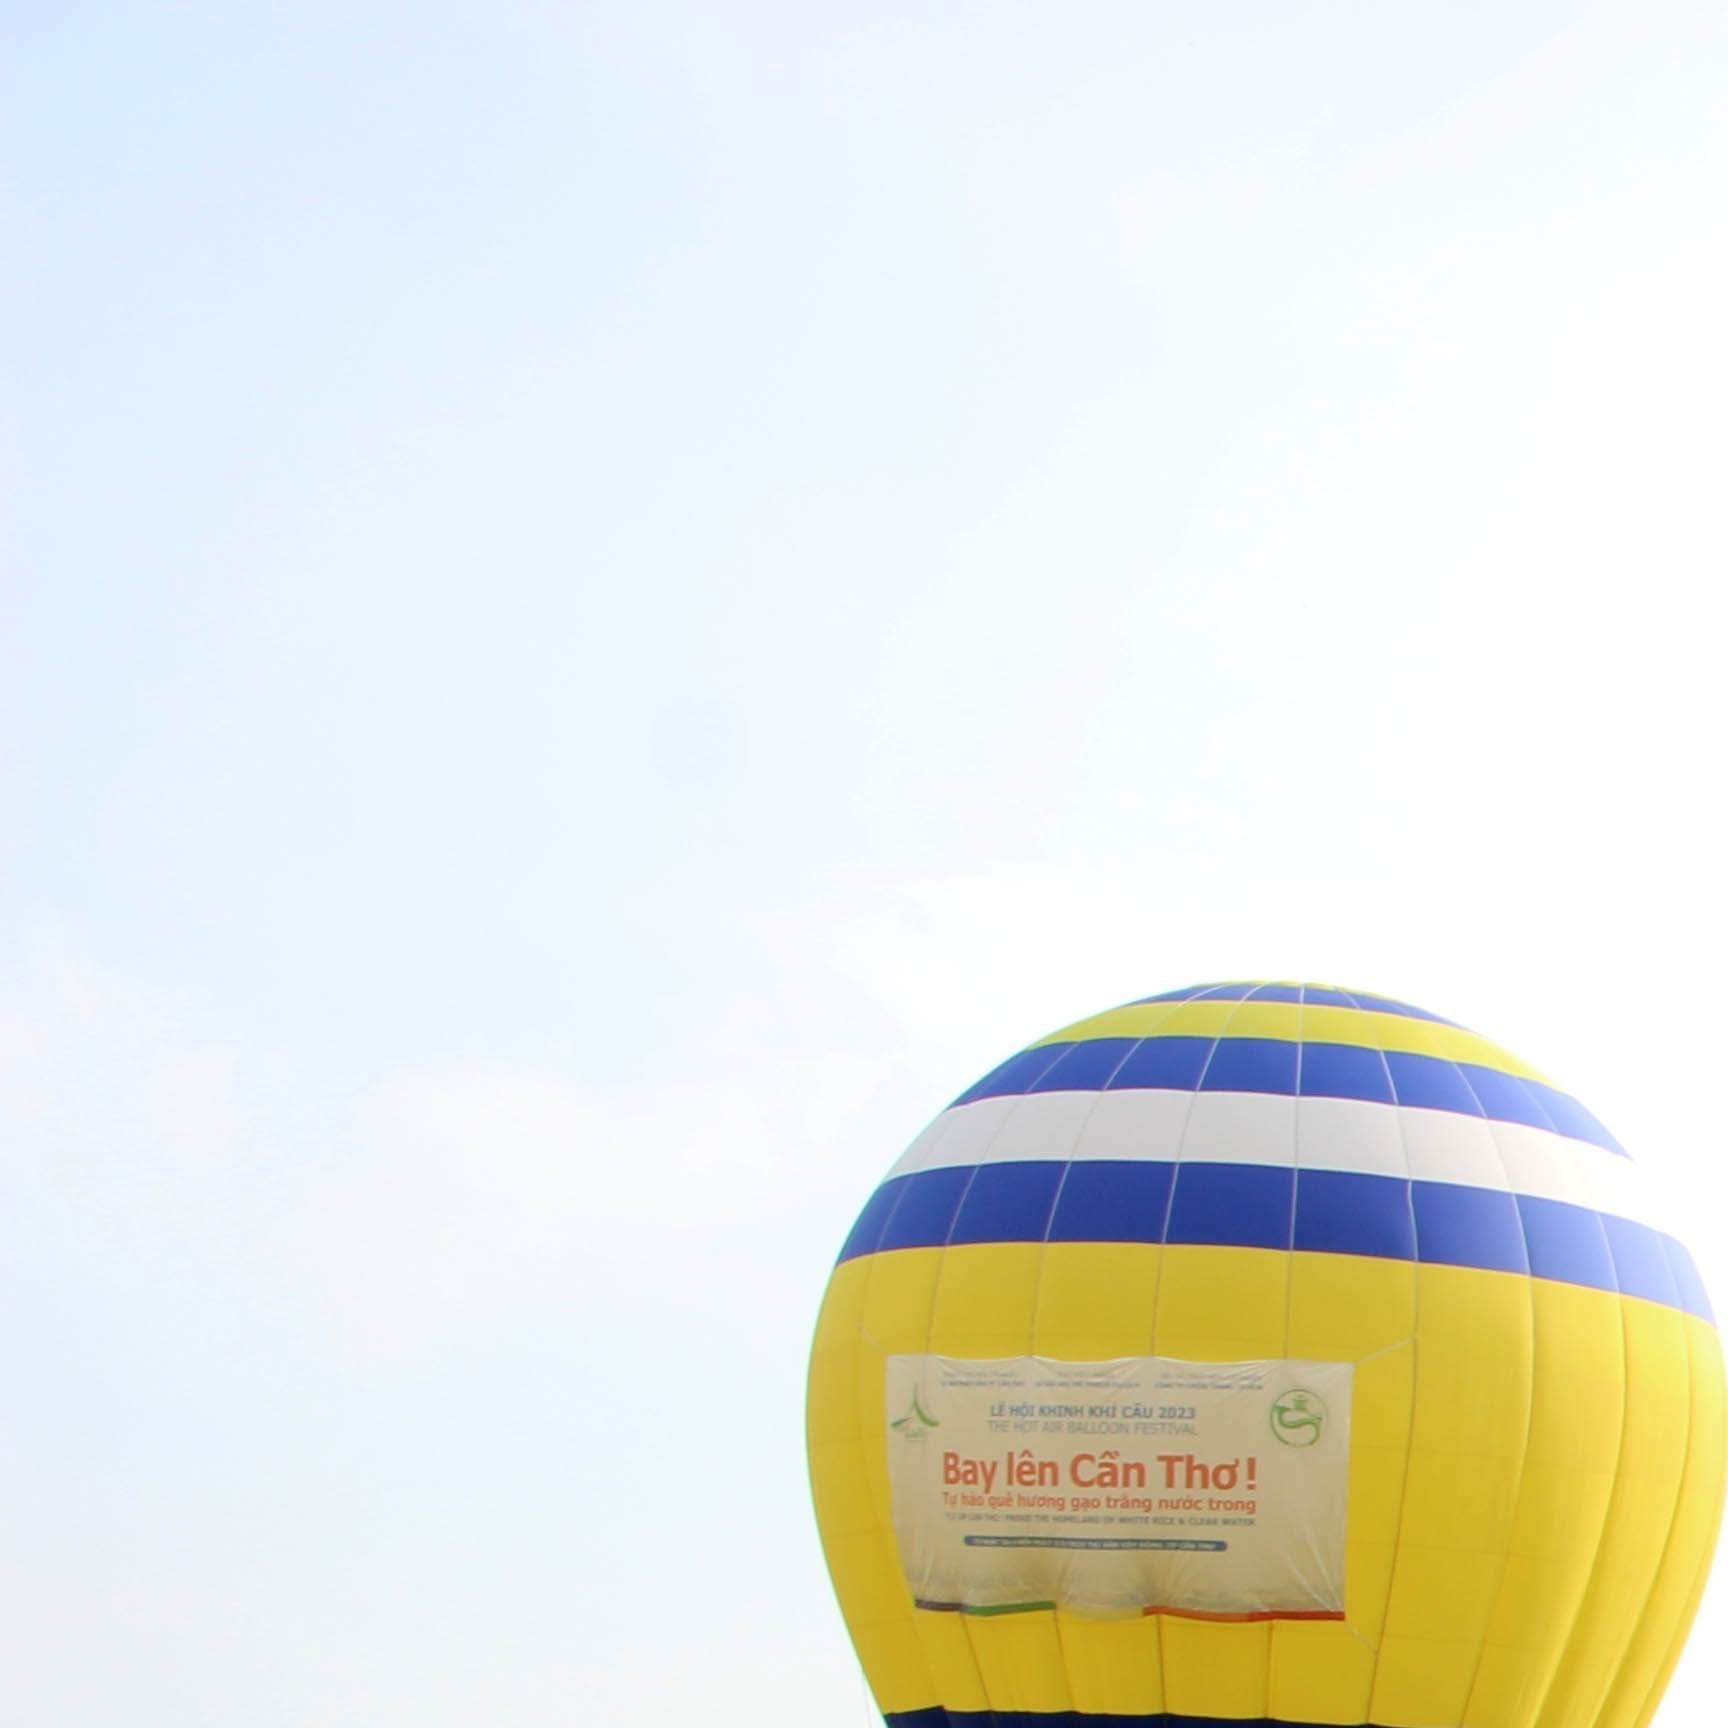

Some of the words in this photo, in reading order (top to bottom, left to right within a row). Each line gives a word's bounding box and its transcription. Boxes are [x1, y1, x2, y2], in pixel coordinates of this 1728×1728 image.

[1010, 1404, 1034, 1419] HỘI
[1039, 1404, 1084, 1418] KHINH
[1088, 1404, 1116, 1418] KHÍ
[1158, 1406, 1196, 1419] 2023
[988, 1420, 1009, 1433] THE
[1067, 1421, 1129, 1434] BALLOON
[1135, 1421, 1199, 1436] FESTIVAL
[943, 1451, 999, 1494] Bay
[1007, 1449, 1060, 1487] lên
[1070, 1450, 1146, 1488] Cần
[988, 1492, 1013, 1508] quê
[1017, 1493, 1065, 1511] hương
[1070, 1496, 1101, 1512] gạo
[1158, 1495, 1203, 1511] nước
[1208, 1497, 1256, 1515] trong
